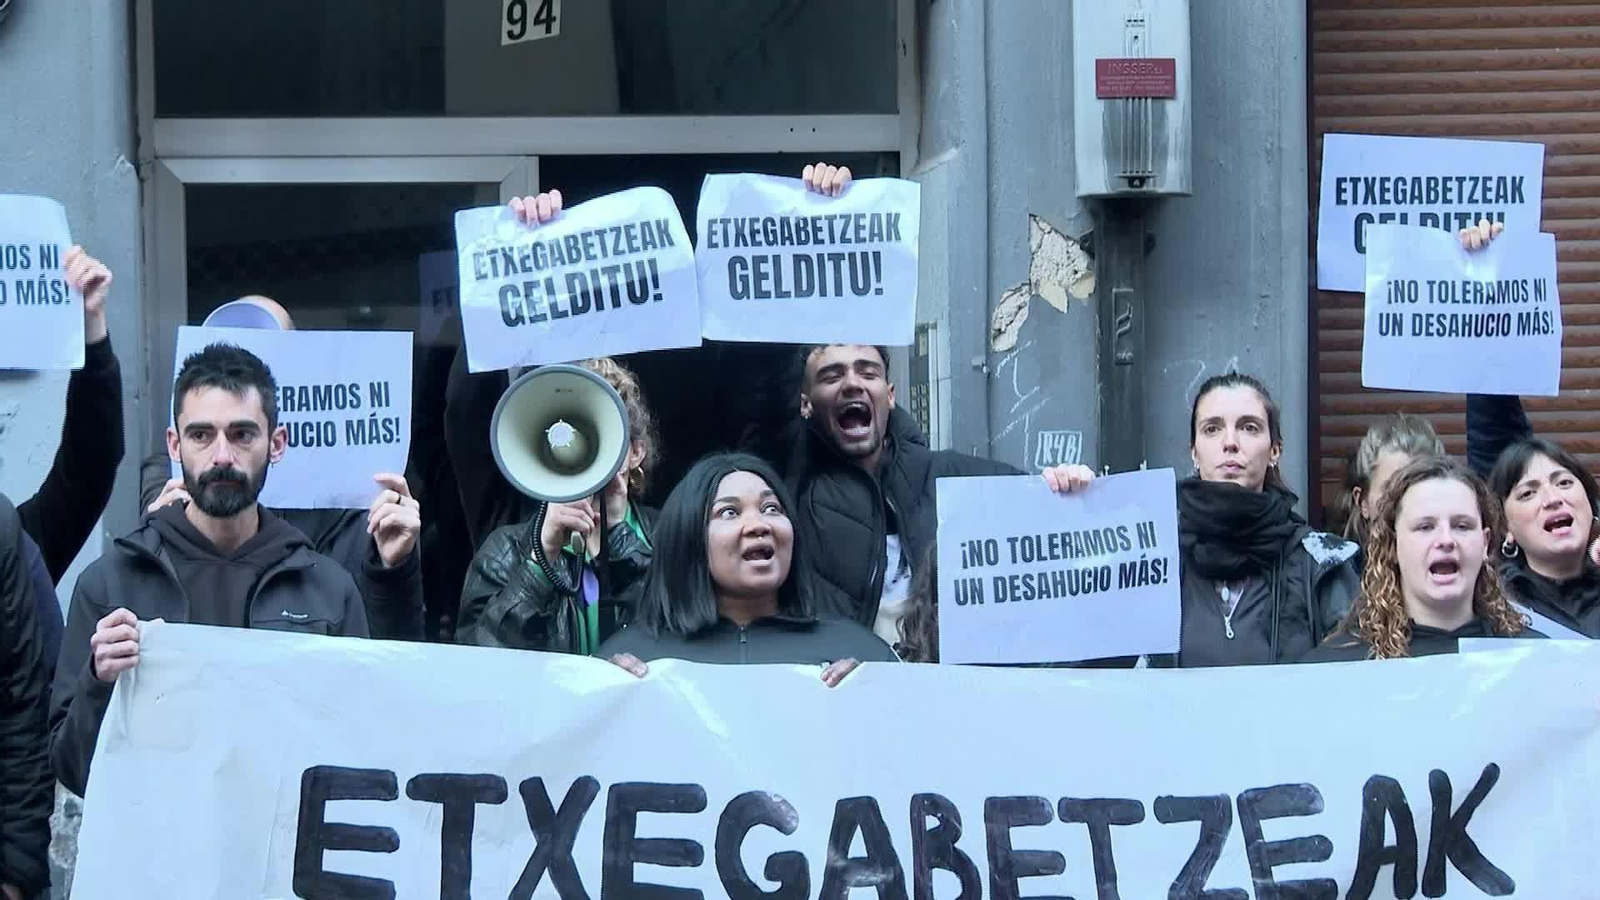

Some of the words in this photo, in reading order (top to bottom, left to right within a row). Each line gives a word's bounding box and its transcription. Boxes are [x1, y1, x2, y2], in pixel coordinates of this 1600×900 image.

[507, 0, 556, 40] 94
[1335, 175, 1525, 206] ETXEGABETZEAK
[707, 212, 902, 249] ETXEGABETZEAK
[40, 244, 59, 270] NI
[473, 218, 676, 281] ETXEGABETZEAK
[16, 273, 70, 305] MÁS!
[499, 258, 664, 328] GELDITU!
[728, 251, 884, 301] GELDITU!
[1387, 280, 1418, 305] ¡NO
[1427, 279, 1529, 305] TOLERAMOS
[1534, 278, 1547, 303] NI
[1379, 312, 1404, 337] UN
[1411, 312, 1511, 338] DESAHUCIO
[1516, 307, 1554, 336] MÁS!
[274, 383, 361, 412] ERAMOS
[370, 381, 390, 408] NI
[278, 421, 336, 448] UCIO
[345, 412, 400, 447] MÁS!
[961, 539, 999, 569] ¡NO
[1007, 525, 1132, 564] TOLERAMOS
[1136, 521, 1157, 549] NI
[954, 578, 984, 606] UN
[993, 565, 1111, 603] DESAHUCIO
[1118, 553, 1168, 589] MÁS!
[293, 762, 1515, 900] ETXEGABETZEAK
